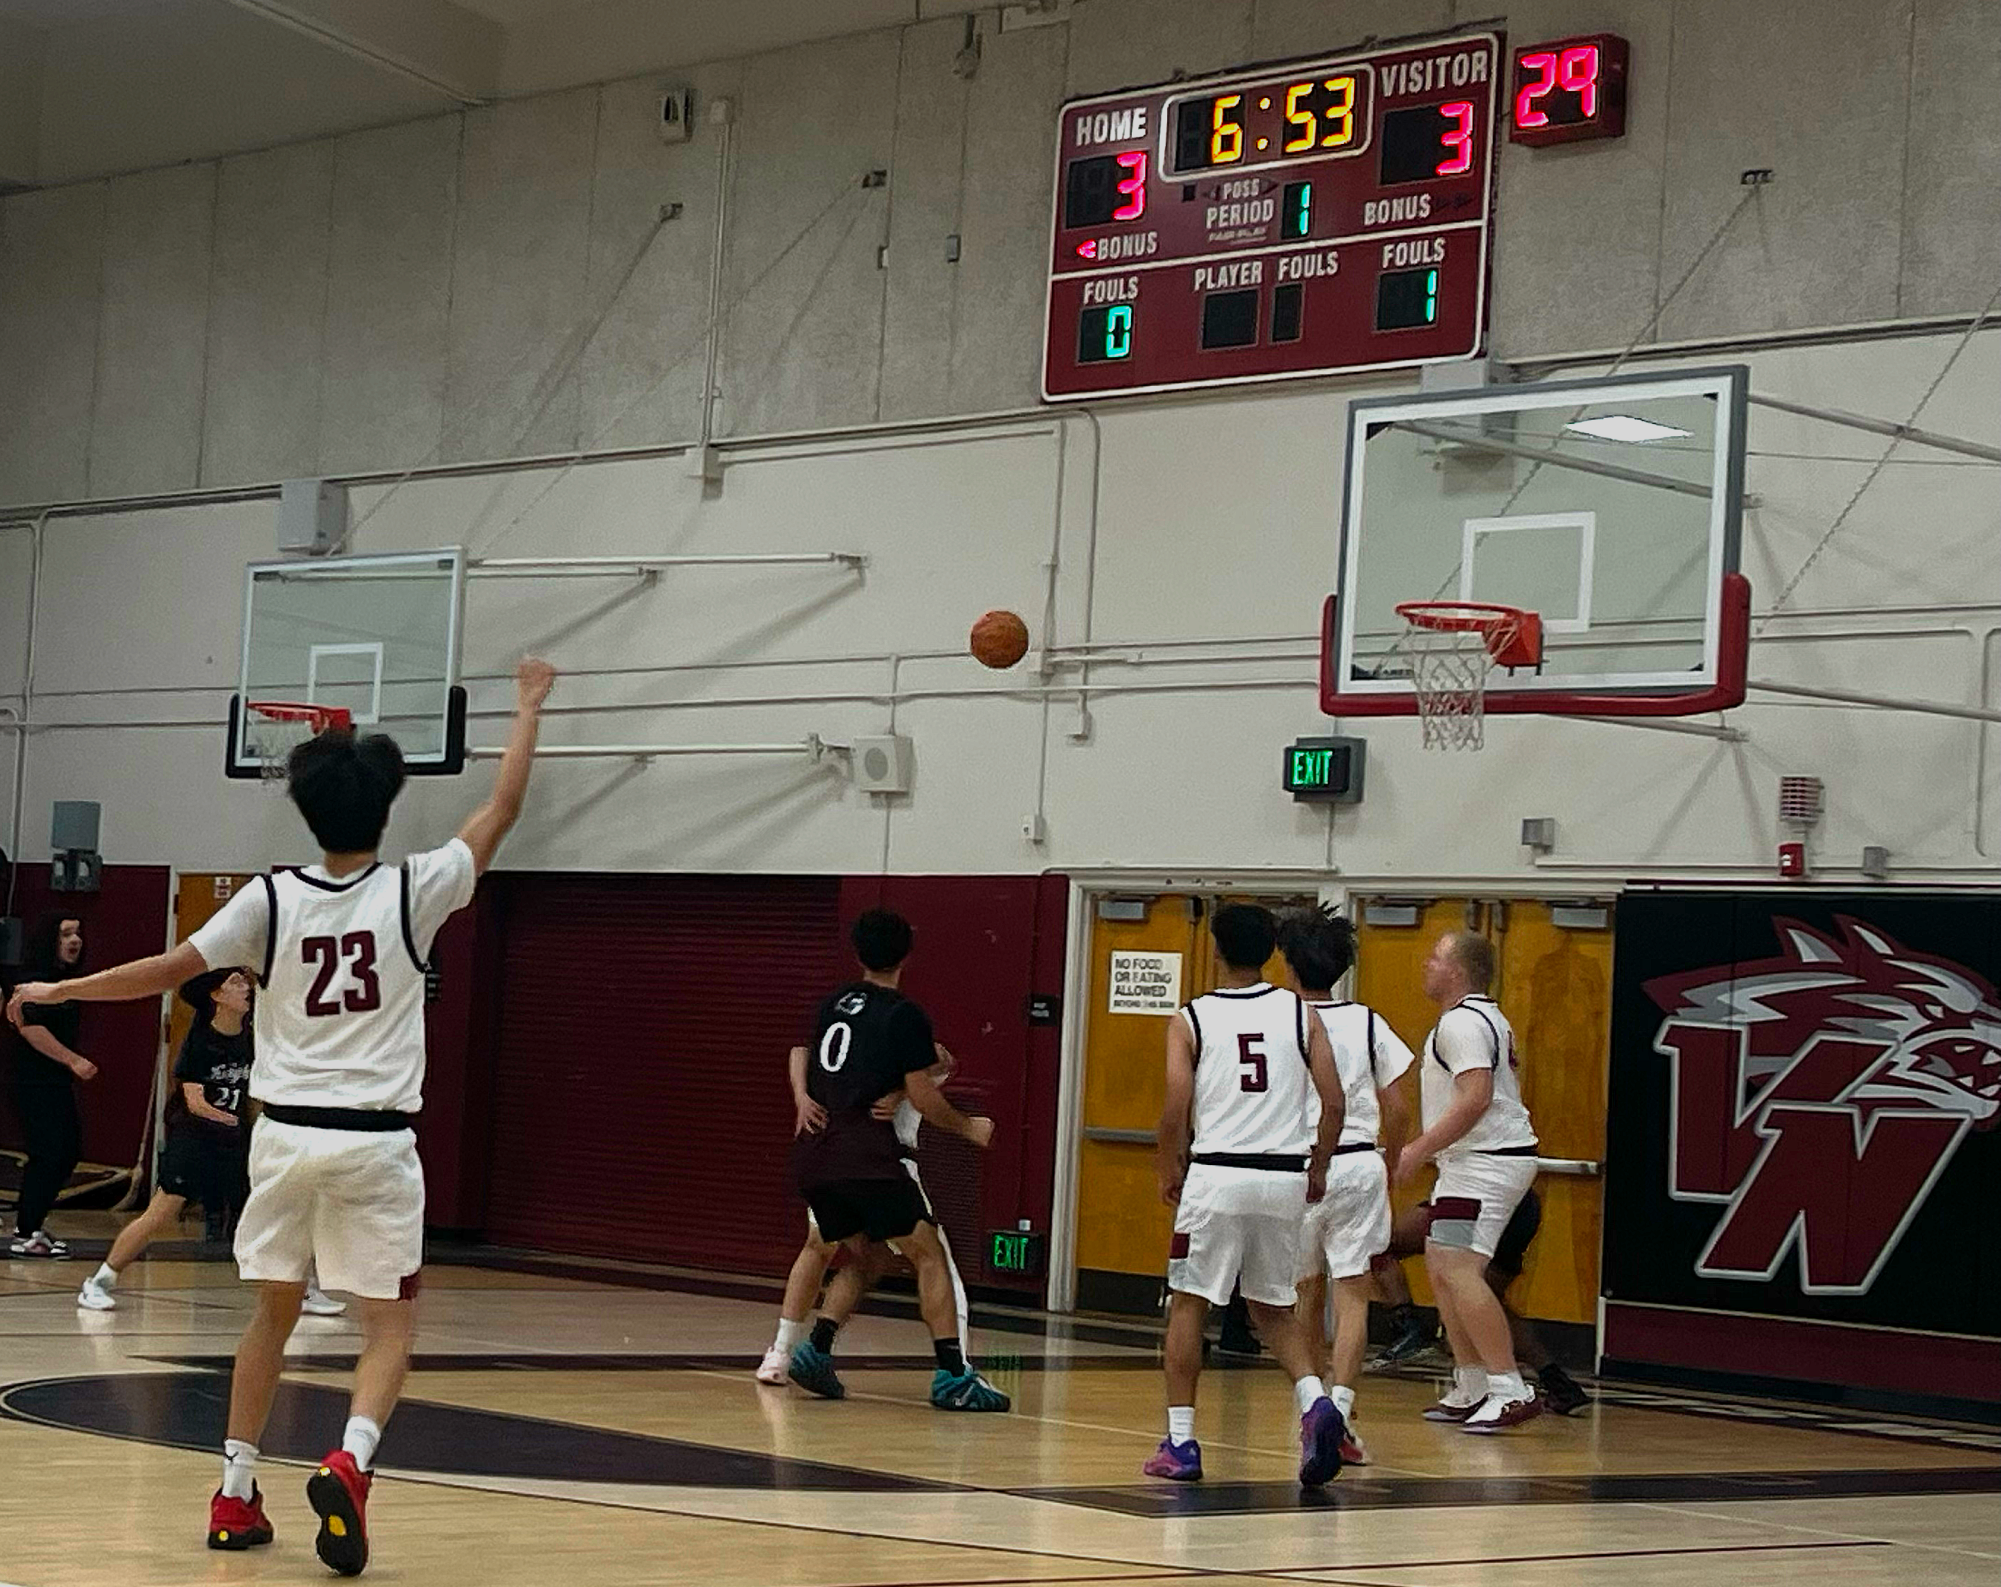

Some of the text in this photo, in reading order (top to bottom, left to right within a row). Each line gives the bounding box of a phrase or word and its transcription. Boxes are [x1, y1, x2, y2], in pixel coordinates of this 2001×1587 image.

[1380, 50, 1489, 99] VISITOR
[1515, 44, 1600, 129] 29
[1075, 106, 1148, 147] HOME
[1211, 76, 1355, 164] 6:53
[1437, 102, 1474, 176] 3
[1112, 151, 1148, 222] 3
[1206, 198, 1275, 229] PERIOD
[1299, 184, 1311, 235] 1
[1364, 193, 1431, 227] BONUS
[1098, 231, 1158, 262] BONUS
[1382, 238, 1446, 268] FOULS
[1083, 275, 1139, 304] FOULS
[1194, 252, 1340, 292] PLAYER FOULS
[1427, 270, 1437, 322] 1
[1106, 305, 1132, 358] 0
[1291, 750, 1333, 786] EXIT
[301, 929, 382, 1017] 23
[1115, 958, 1131, 970] NO
[820, 1021, 851, 1073] 0
[1237, 1032, 1268, 1093] 5
[213, 1087, 241, 1111] 21
[993, 1234, 1029, 1270] EXIT
